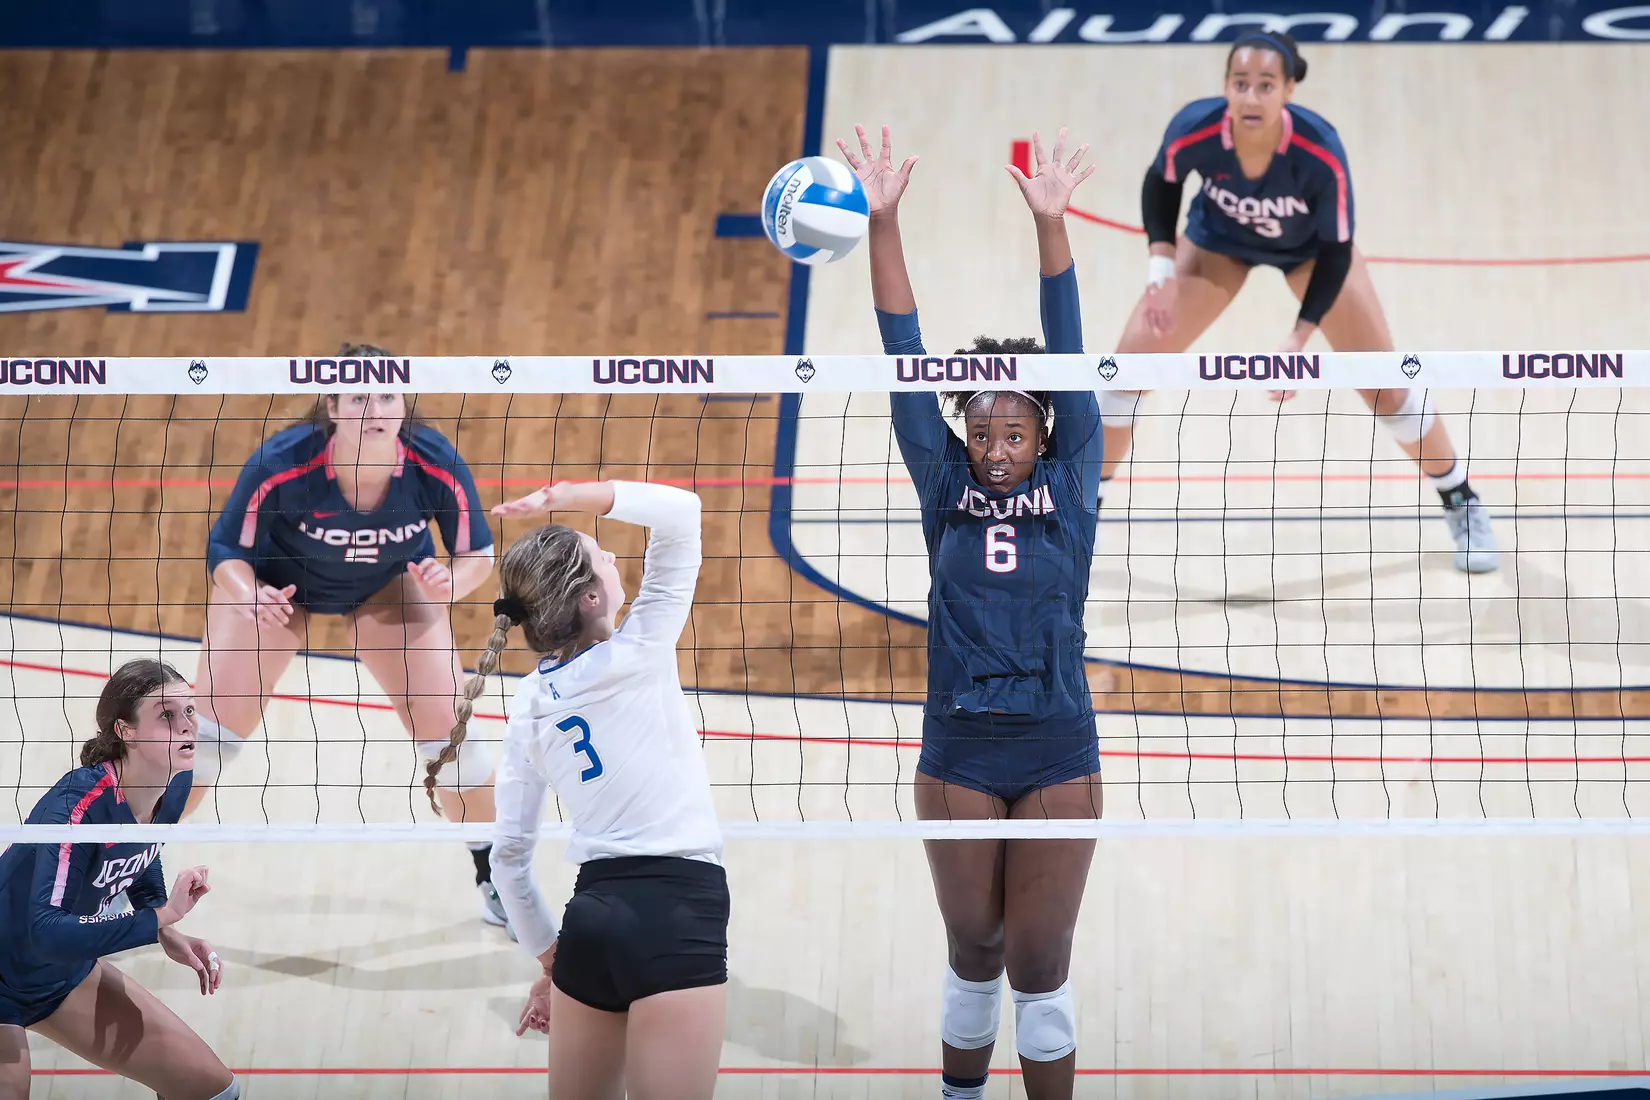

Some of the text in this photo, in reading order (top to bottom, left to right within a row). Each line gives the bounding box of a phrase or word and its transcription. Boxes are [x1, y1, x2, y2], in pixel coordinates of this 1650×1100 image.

[896, 6, 1530, 42] Alumni
[777, 178, 801, 236] molten
[289, 358, 410, 385] UCONN
[592, 357, 714, 384] UCONN
[896, 356, 1017, 382] UCONN
[1199, 355, 1320, 381] UCONN
[1501, 353, 1623, 380] UCONN
[298, 518, 428, 547] UCONN
[985, 522, 1018, 573] 6
[554, 713, 605, 784] 3
[92, 843, 160, 889] UCON
